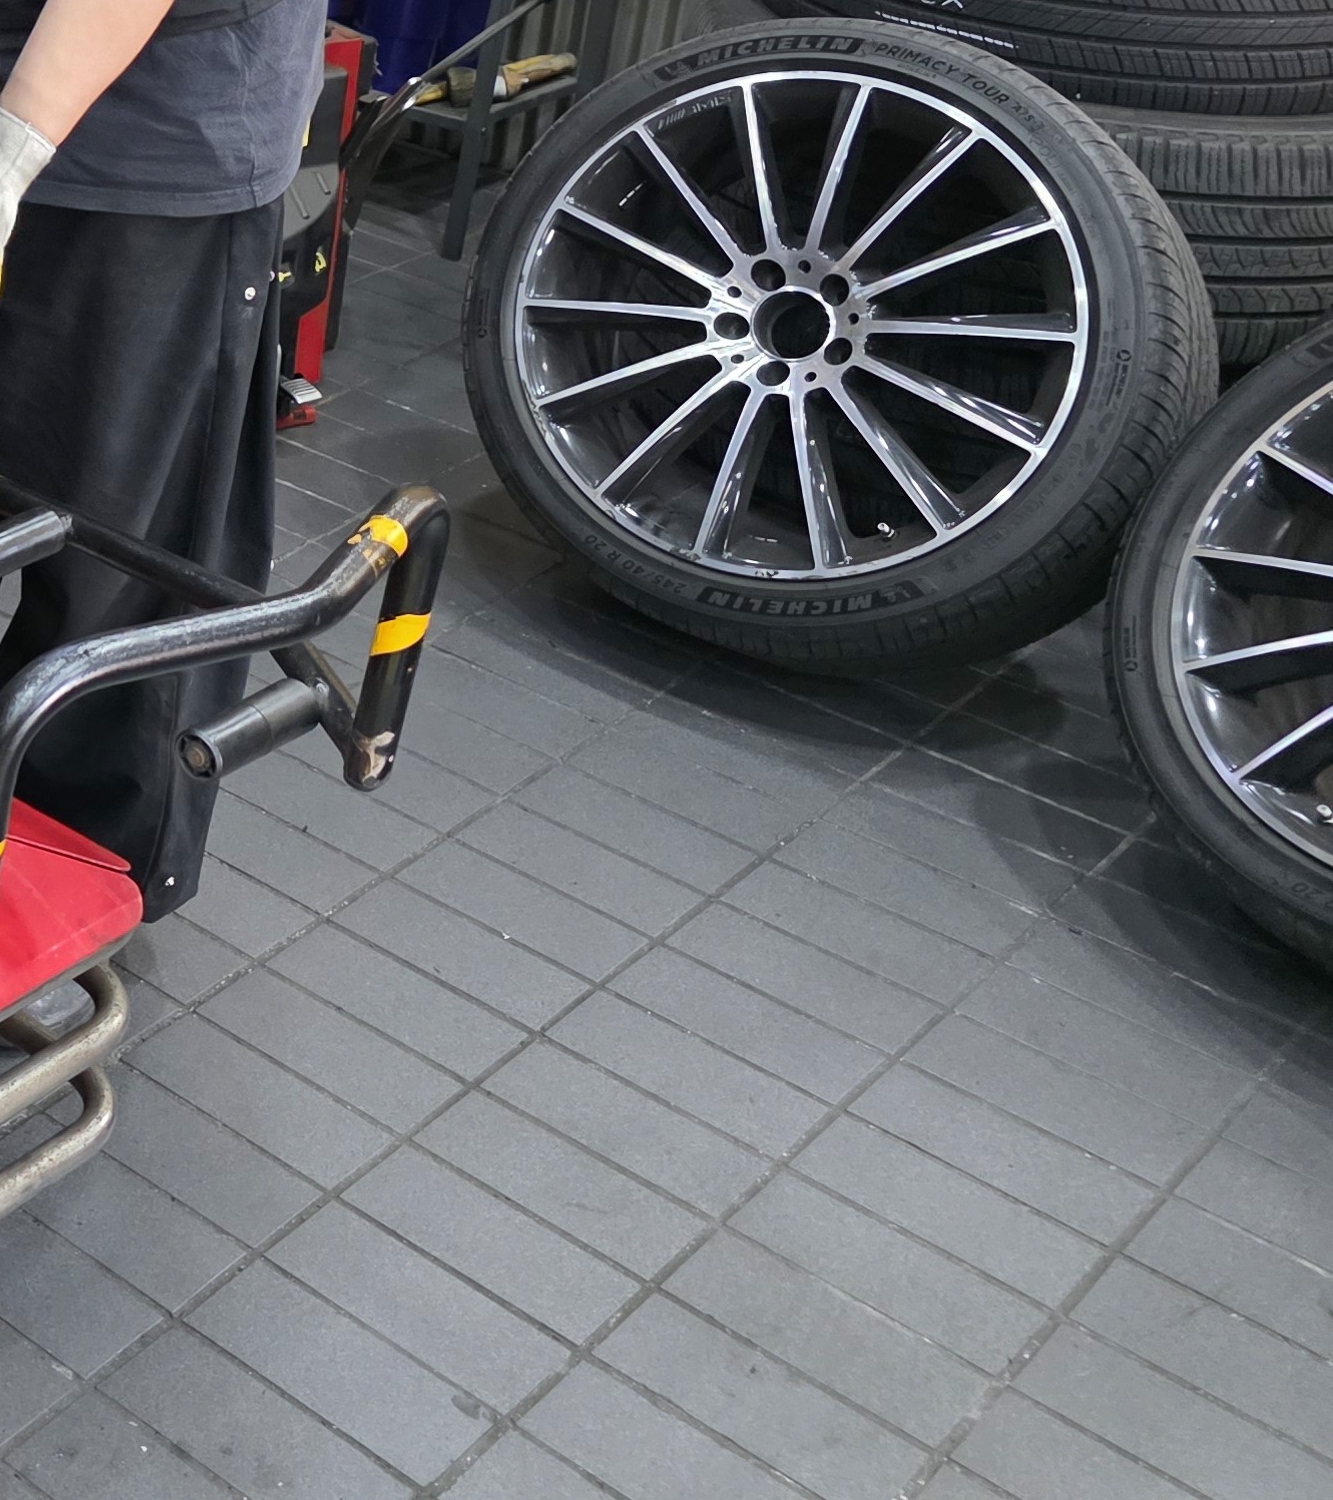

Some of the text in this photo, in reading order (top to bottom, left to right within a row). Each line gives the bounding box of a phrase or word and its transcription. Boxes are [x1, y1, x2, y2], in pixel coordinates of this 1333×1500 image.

[697, 36, 855, 65] MICHELIN
[874, 42, 963, 78] PRIMACY
[964, 72, 1013, 106] TOUR
[707, 588, 873, 615] MICHELIN
